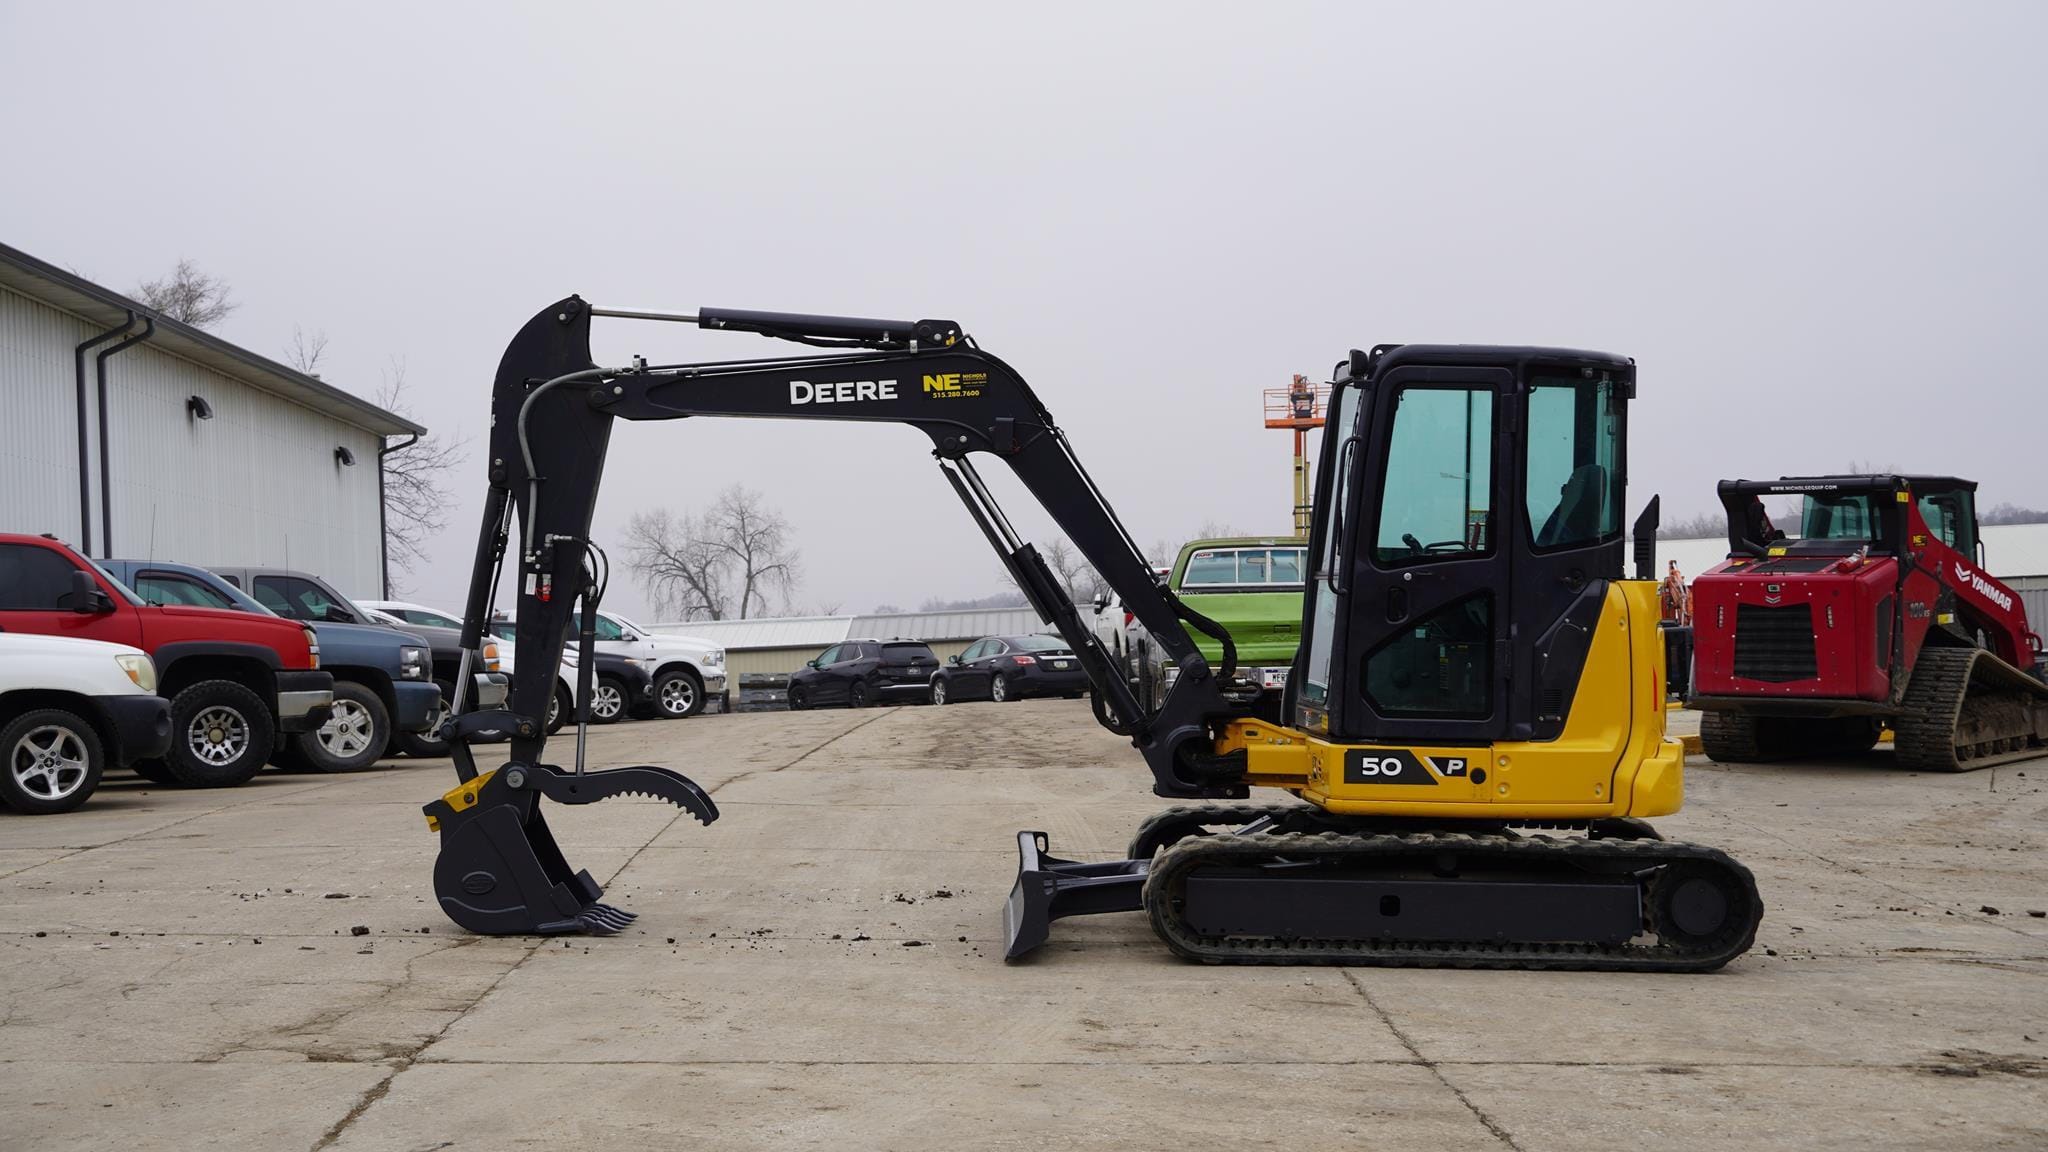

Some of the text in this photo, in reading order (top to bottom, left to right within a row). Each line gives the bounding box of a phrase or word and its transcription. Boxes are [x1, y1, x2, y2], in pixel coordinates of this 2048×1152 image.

[923, 373, 961, 392] NE
[790, 380, 898, 405] DEERE
[932, 390, 980, 399] 515.280.7600
[1972, 573, 2012, 612] YANMAR
[1362, 757, 1464, 776] 50 P
